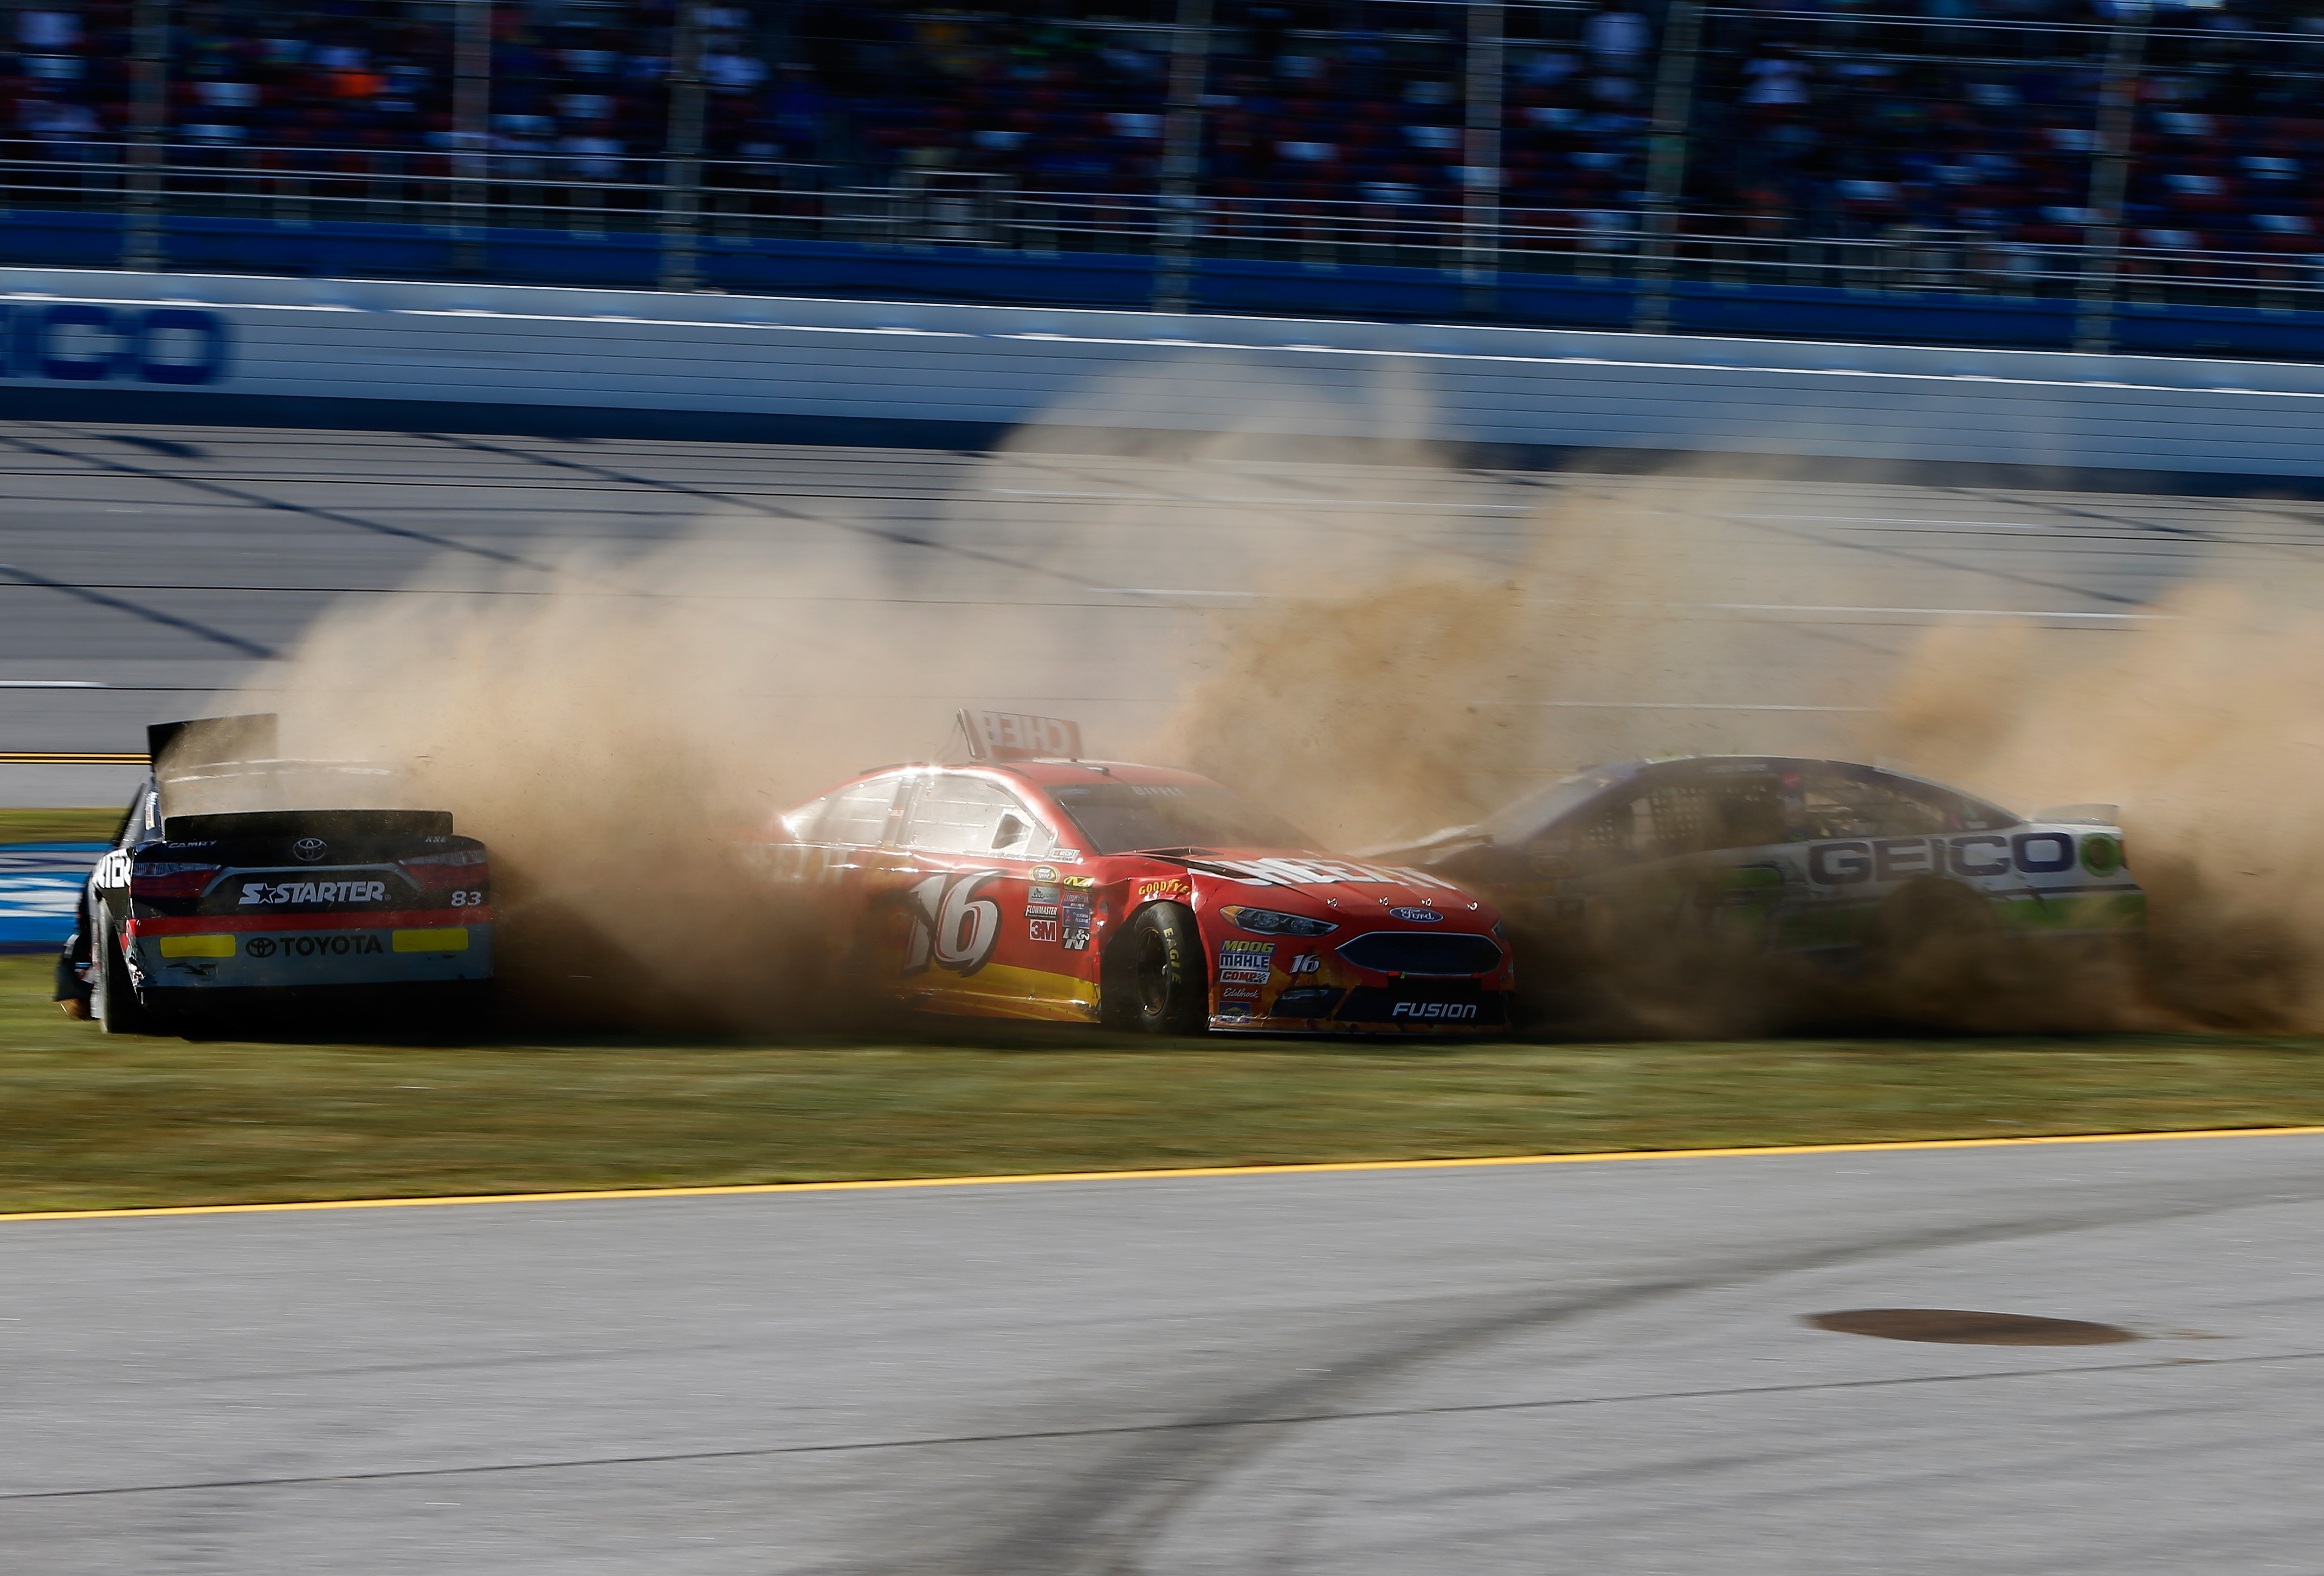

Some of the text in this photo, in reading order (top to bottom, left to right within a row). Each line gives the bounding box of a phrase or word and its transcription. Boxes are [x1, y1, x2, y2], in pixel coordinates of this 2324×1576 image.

[0, 305, 231, 385] ICO
[1809, 832, 2075, 886] GEICO
[451, 891, 481, 907] 83
[1025, 906, 1057, 916] FLOWMASTER
[1400, 908, 1435, 920] Ford
[902, 870, 1001, 973] 16
[1031, 920, 1055, 941] 3M
[279, 935, 383, 957] TOYOTA
[1222, 940, 1276, 953] MOOG
[1221, 954, 1269, 968] MAHLE
[1289, 954, 1322, 974] 16
[1222, 971, 1257, 980] COMP
[1392, 1003, 1477, 1018] FUSION
